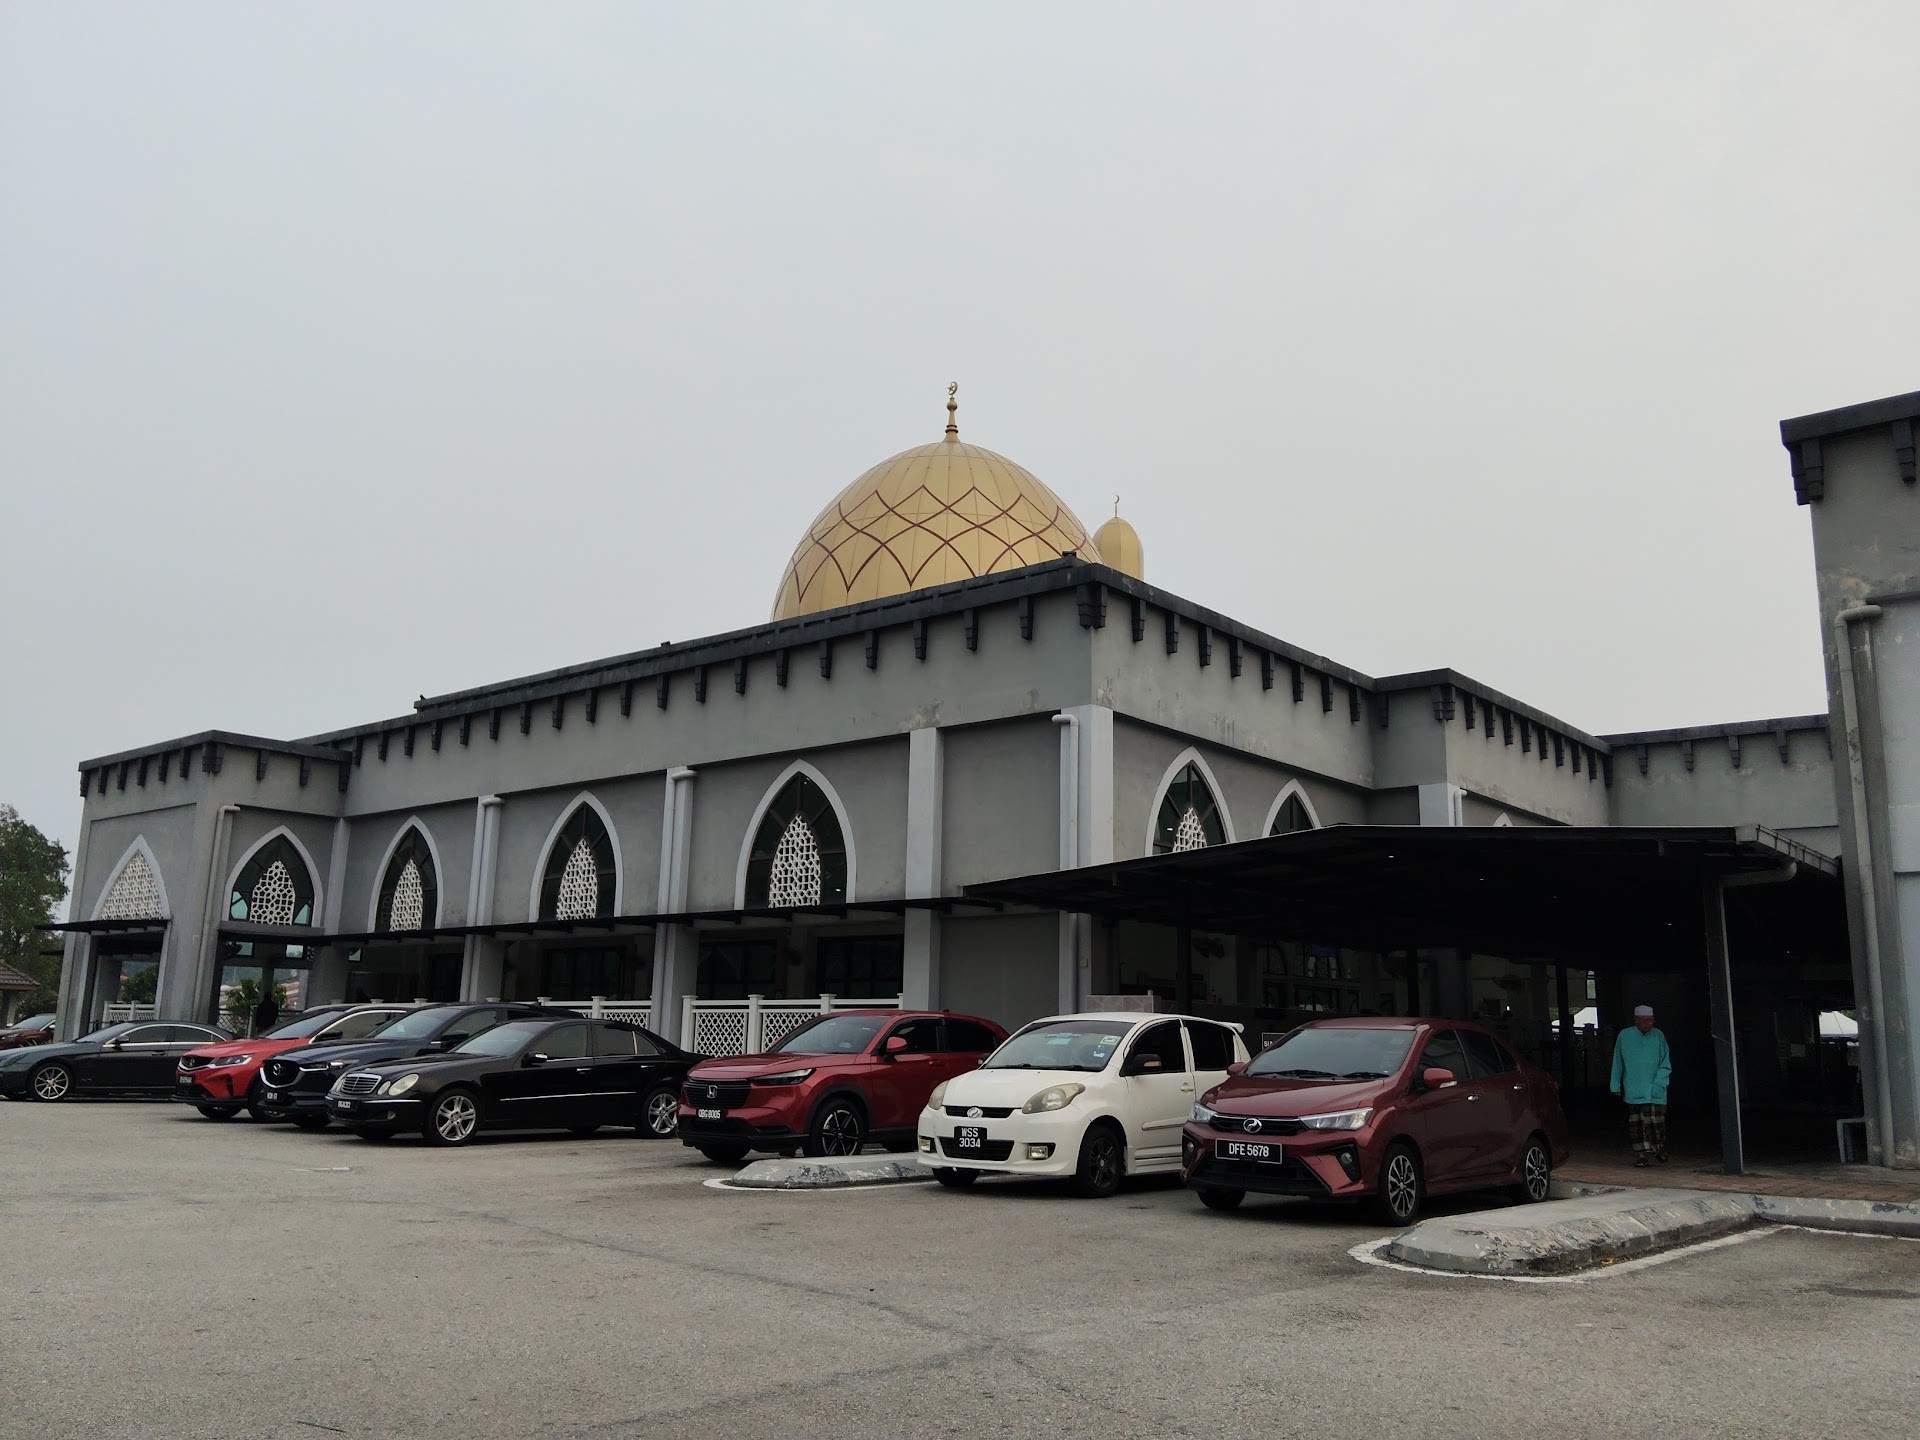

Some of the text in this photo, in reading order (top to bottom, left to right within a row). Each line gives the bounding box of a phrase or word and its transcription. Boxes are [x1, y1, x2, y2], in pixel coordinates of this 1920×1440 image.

[961, 1127, 979, 1138] WSS
[958, 1137, 981, 1148] 3034
[1228, 1142, 1270, 1158] DFE 5678
